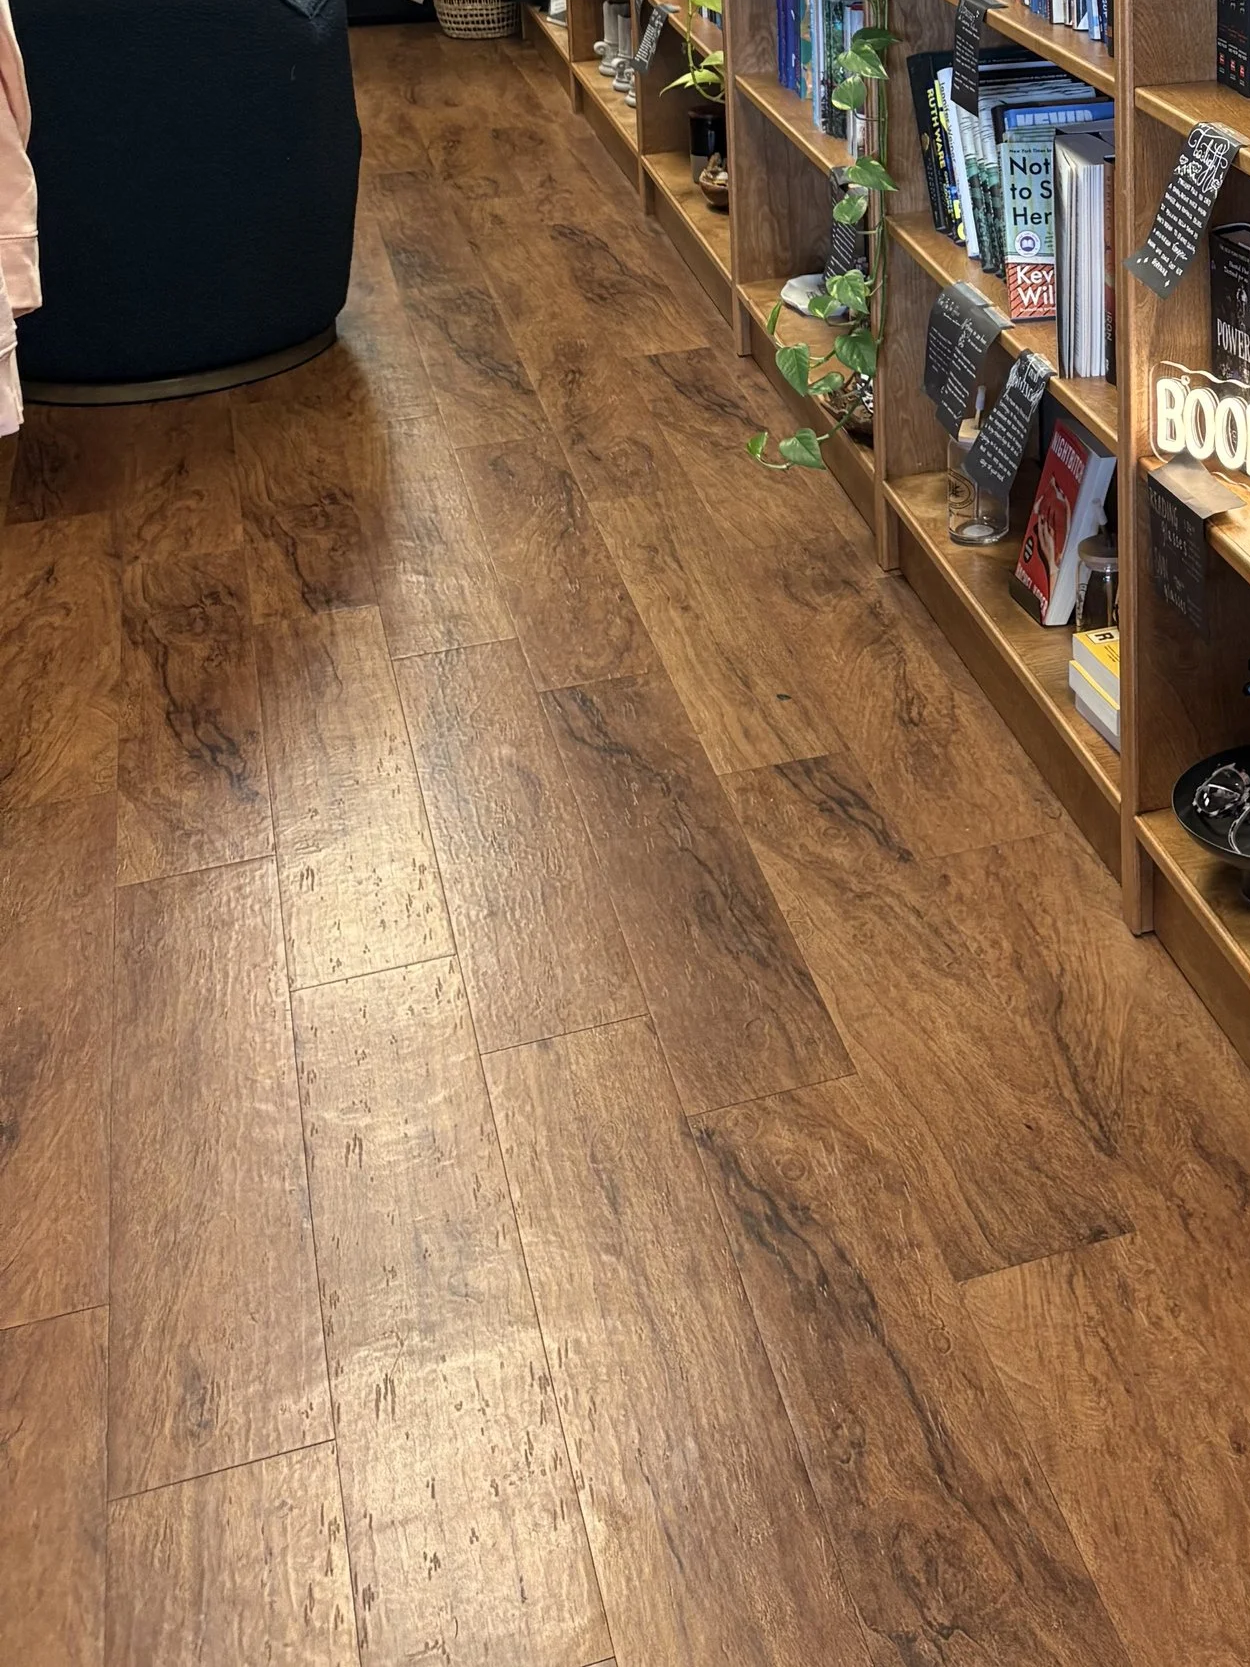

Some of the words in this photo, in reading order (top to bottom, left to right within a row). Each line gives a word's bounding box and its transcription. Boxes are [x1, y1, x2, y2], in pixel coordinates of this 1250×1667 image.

[927, 88, 939, 127] RUTH
[933, 128, 945, 168] WARE
[1009, 156, 1051, 176] Not
[1010, 185, 1033, 201] to
[1018, 266, 1053, 285] Kev
